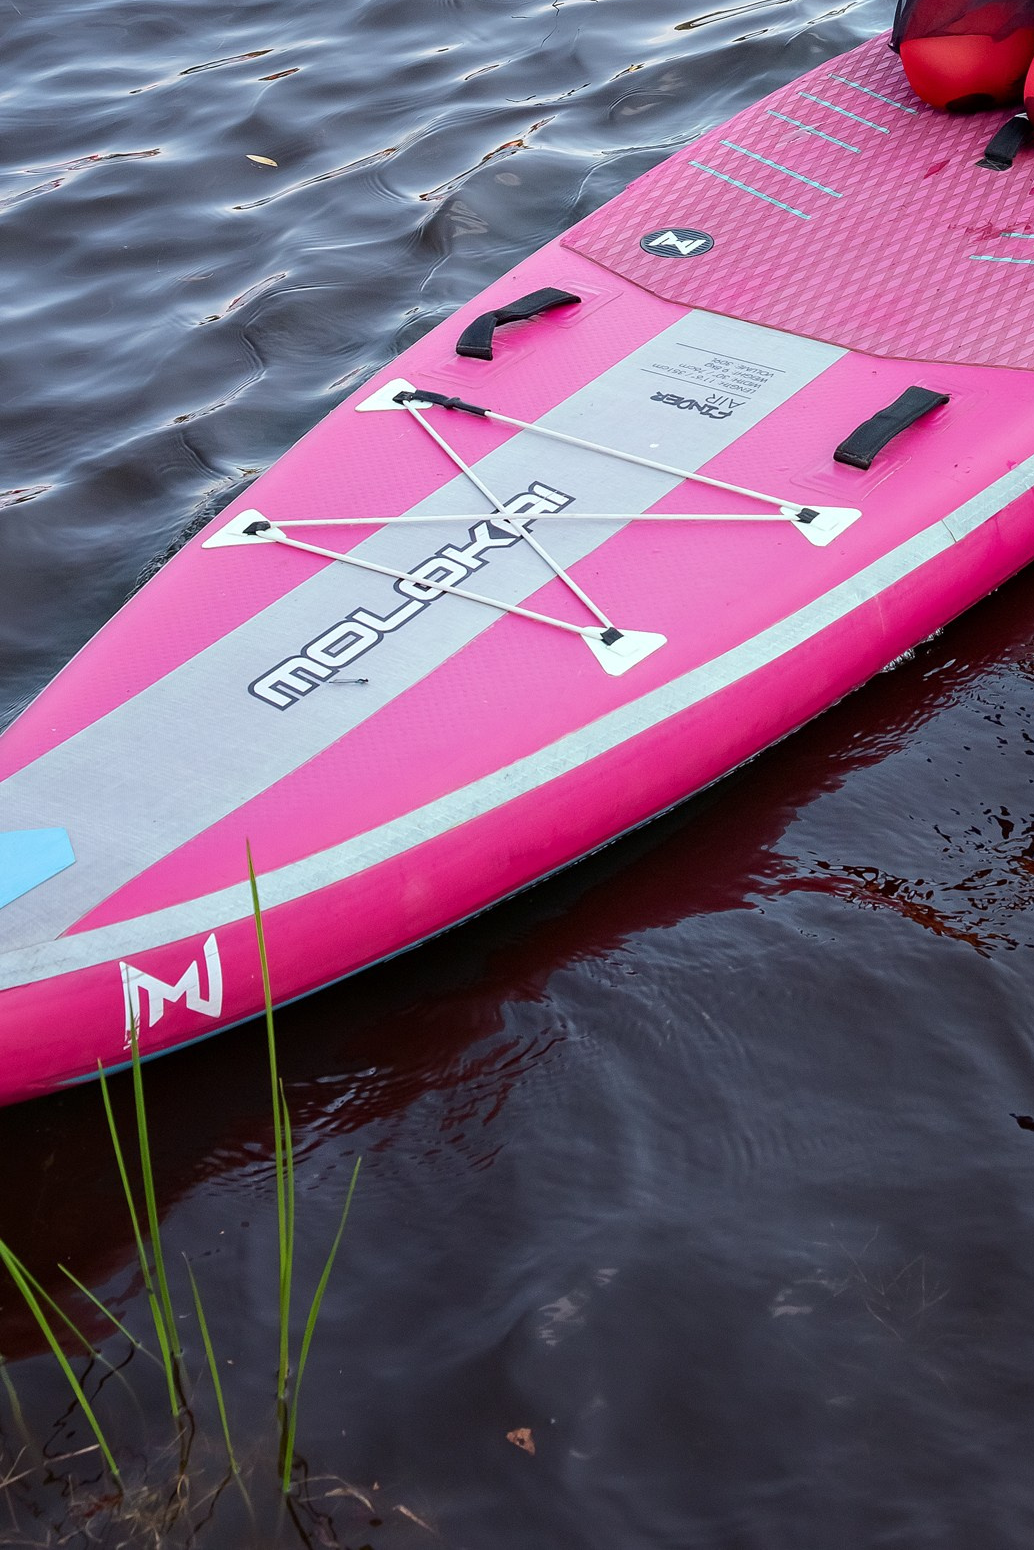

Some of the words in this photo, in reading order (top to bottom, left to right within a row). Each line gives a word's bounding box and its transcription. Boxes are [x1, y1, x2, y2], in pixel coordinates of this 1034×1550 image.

[733, 371, 768, 383] WEIGHT:
[735, 364, 774, 378] VOLUME:
[718, 382, 757, 394] LENGTH:
[732, 378, 761, 389] WIDTH:
[650, 391, 733, 419] FINDER
[705, 394, 746, 409] AIR
[247, 480, 576, 712] MOLOKAI
